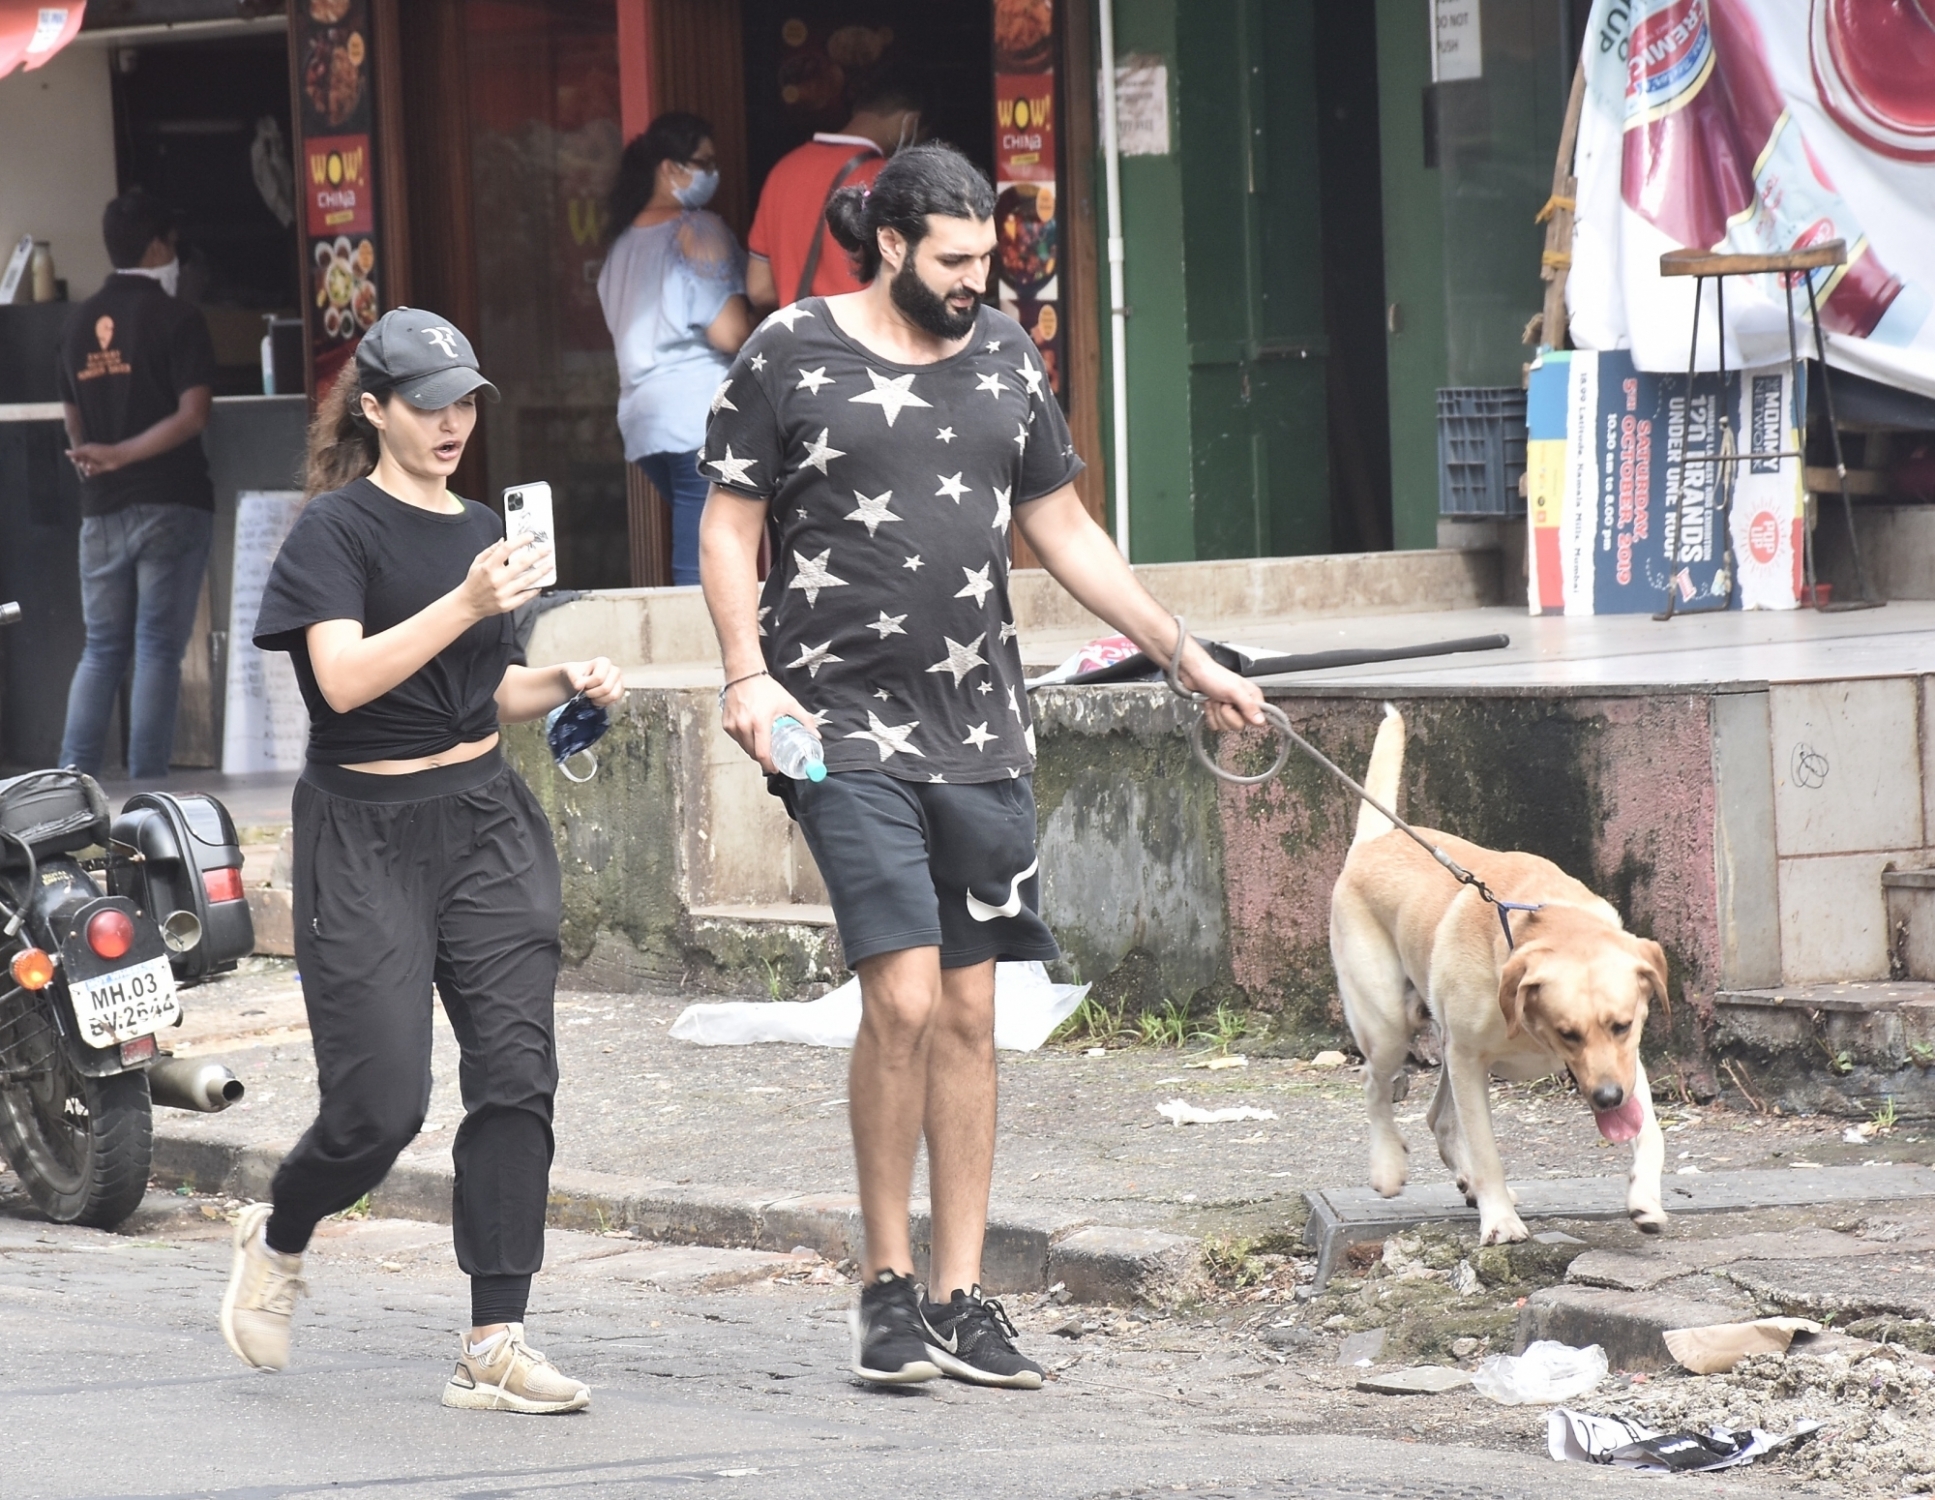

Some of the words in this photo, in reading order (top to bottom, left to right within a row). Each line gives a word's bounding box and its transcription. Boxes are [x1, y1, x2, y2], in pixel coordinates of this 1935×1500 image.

[1449, 12, 1469, 27] NOT
[998, 94, 1052, 132] WOW!
[310, 145, 364, 187] WOW!
[1666, 397, 1685, 462] UNDER
[1763, 391, 1780, 471] MOMMY
[1605, 452, 1614, 474] am
[1617, 414, 1637, 529] OCTOBER,
[1632, 419, 1652, 543] SATURDAY,
[1605, 476, 1614, 492] to
[1681, 450, 1706, 563] BRANDS
[1602, 529, 1612, 551] pm
[1751, 526, 1763, 549] UP
[1763, 520, 1776, 554] POP
[1616, 532, 1633, 585] 2019
[90, 973, 158, 1010] MH.03
